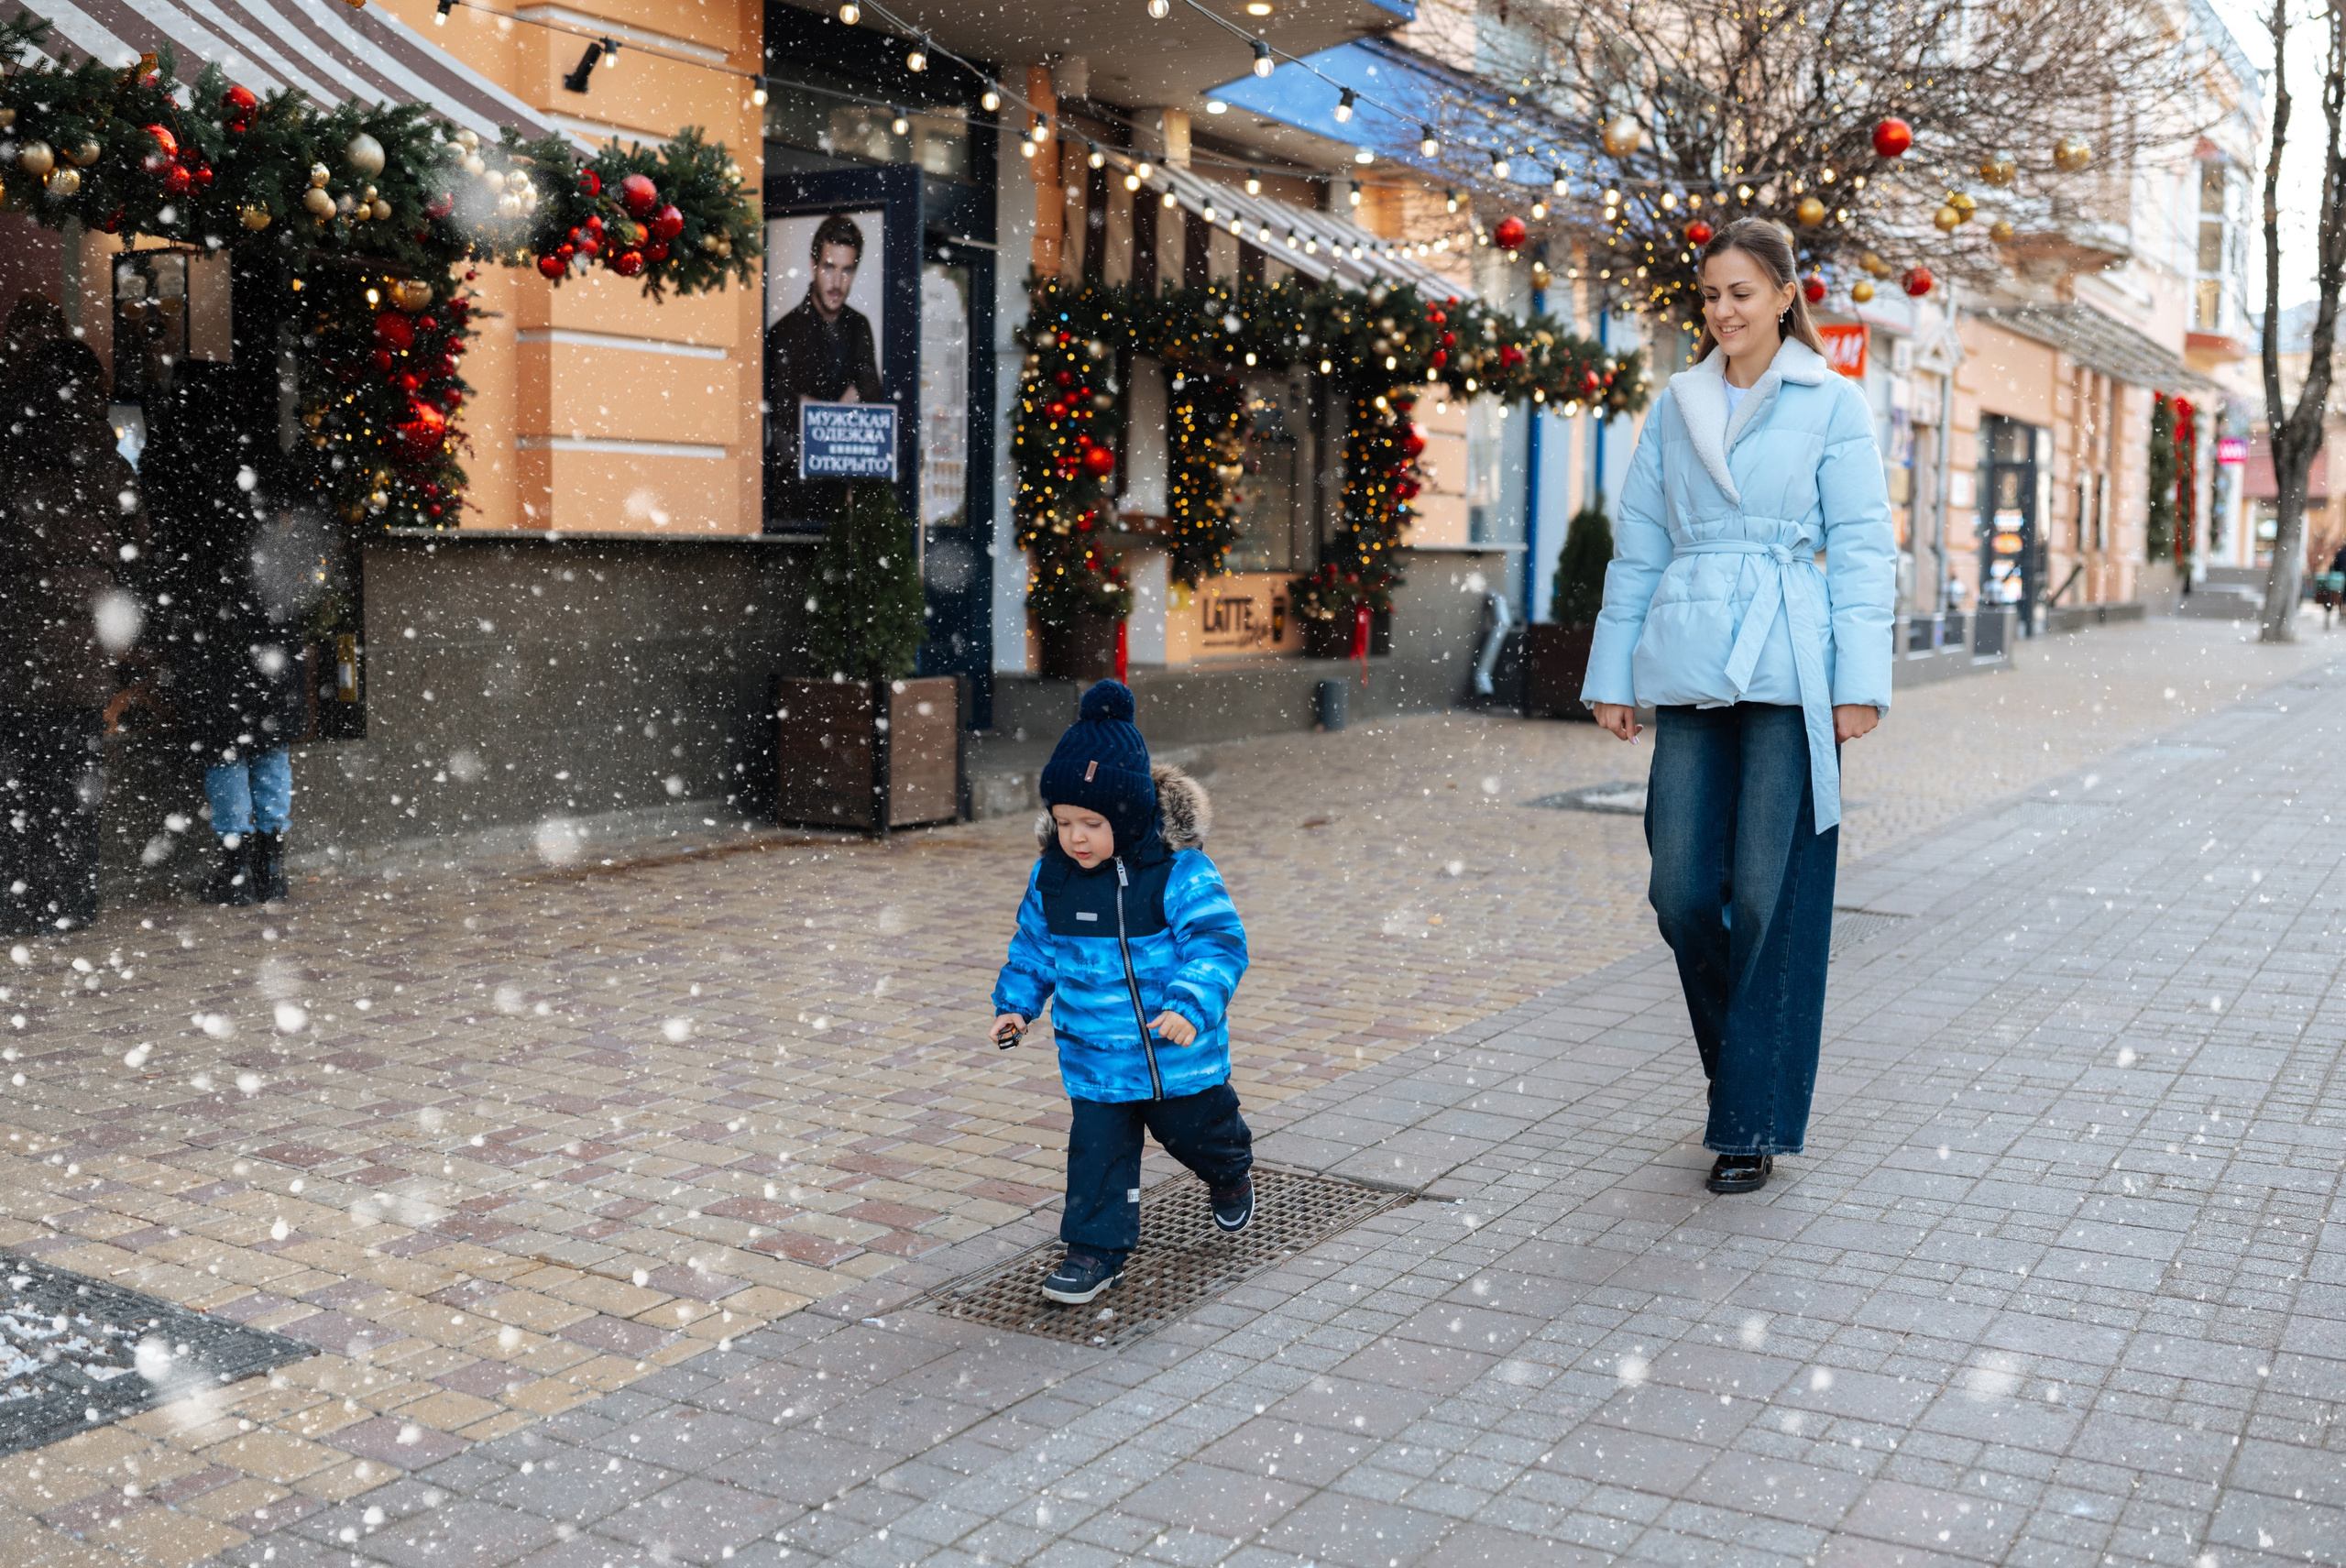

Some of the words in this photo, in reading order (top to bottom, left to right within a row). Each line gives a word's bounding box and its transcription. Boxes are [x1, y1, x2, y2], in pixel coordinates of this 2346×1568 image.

[806, 411, 891, 429] МУЖСКАЯ
[811, 426, 885, 444] ОДЕЖДА
[808, 455, 889, 473] ОТКРЫТО
[1203, 598, 1252, 632] LATTE
